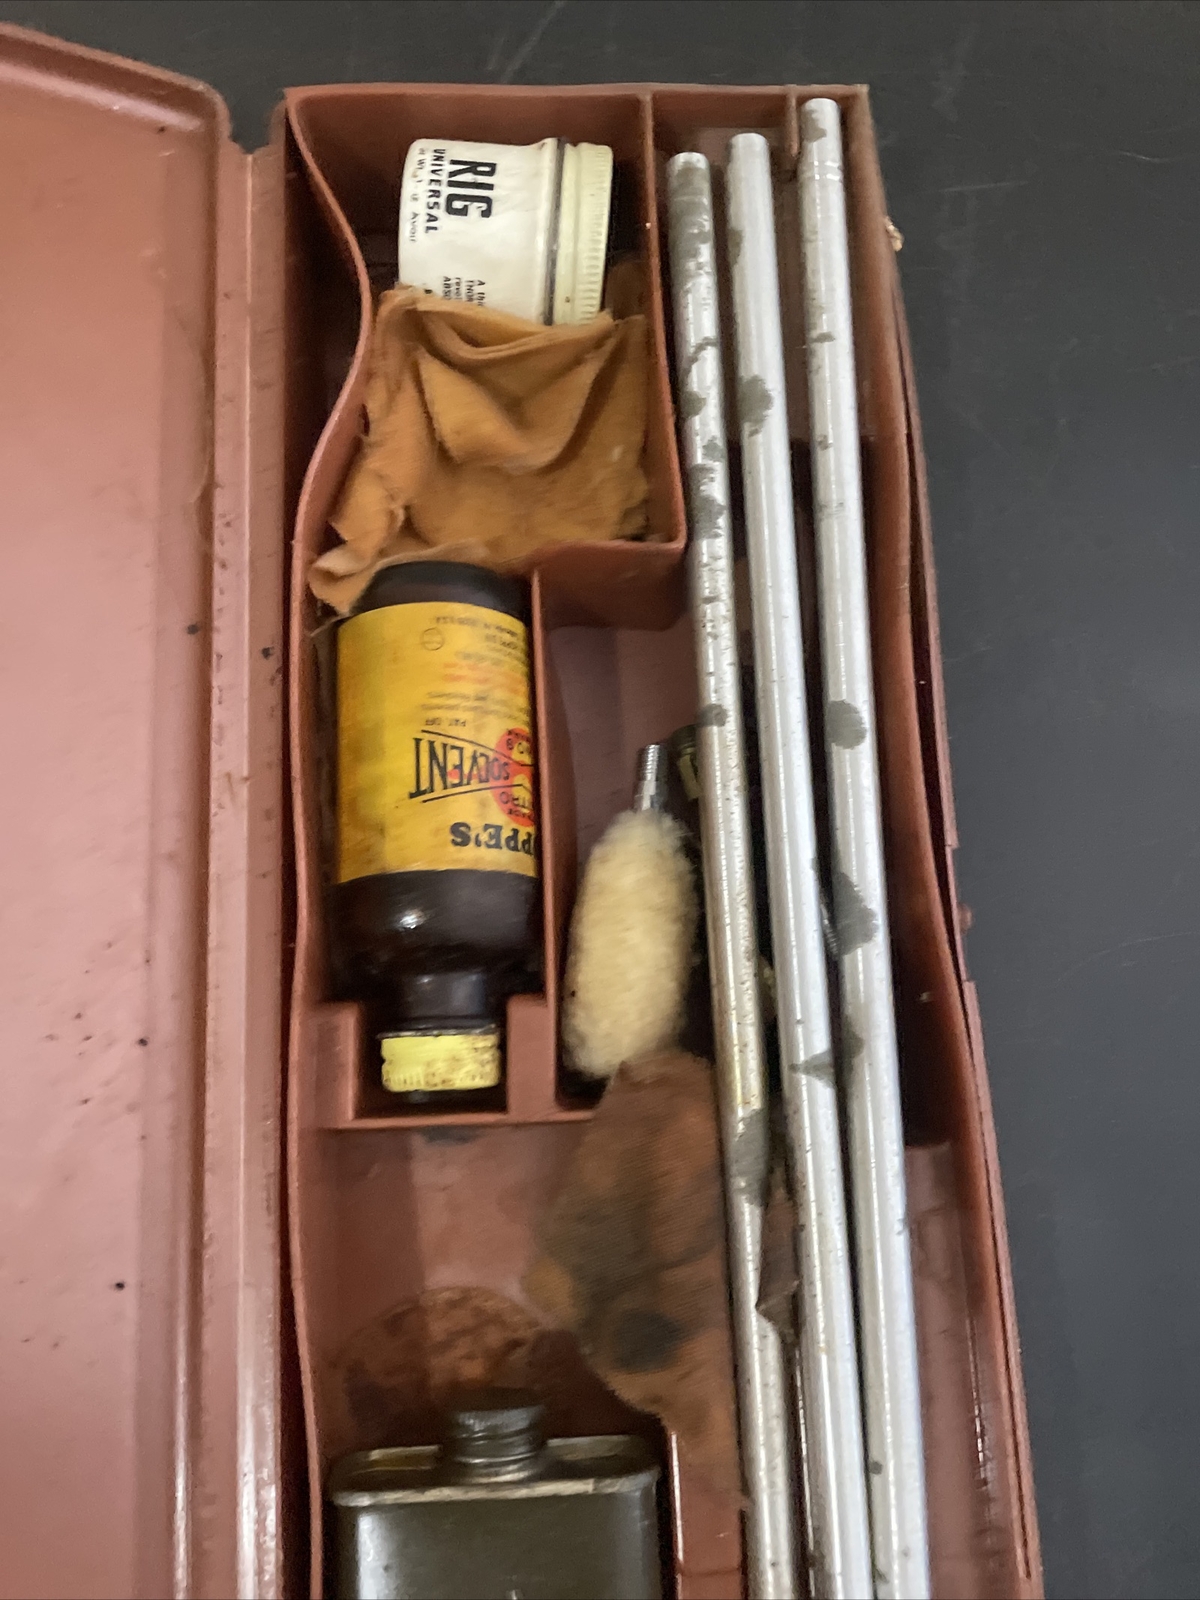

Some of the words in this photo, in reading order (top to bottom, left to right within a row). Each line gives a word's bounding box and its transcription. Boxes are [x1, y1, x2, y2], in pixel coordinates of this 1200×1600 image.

[424, 148, 446, 235] UNIVERSAL
[445, 159, 498, 219] RIG
[408, 737, 511, 799] SOLVENT
